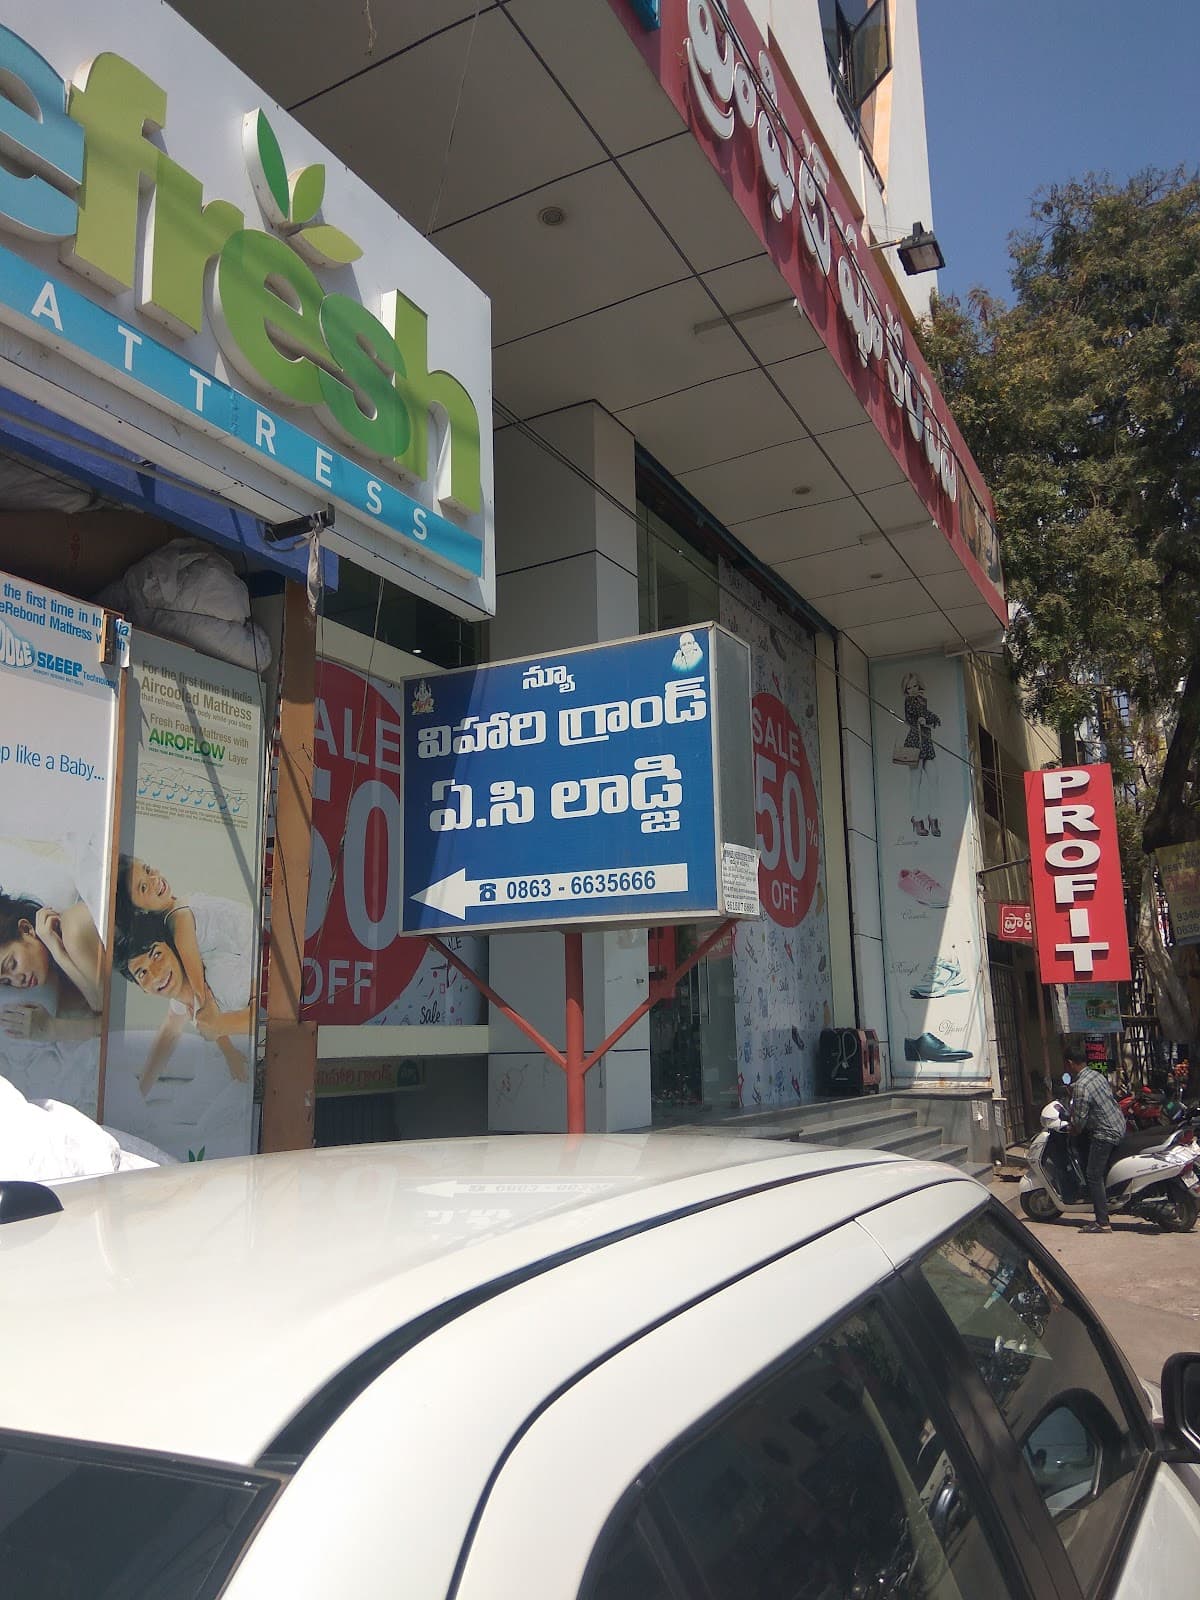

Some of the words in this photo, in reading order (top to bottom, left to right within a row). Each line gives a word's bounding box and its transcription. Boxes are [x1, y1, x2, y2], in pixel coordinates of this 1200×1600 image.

[4, 584, 21, 600] the
[26, 591, 46, 609] first
[50, 600, 74, 618] time
[79, 608, 88, 623] in
[50, 616, 92, 641] Mattress
[38, 651, 83, 677] SLEEP
[143, 660, 158, 674] For
[161, 667, 177, 680] the
[179, 672, 198, 687] first
[200, 679, 219, 693] time
[222, 685, 230, 697] in
[232, 689, 253, 705] India
[522, 665, 576, 693] న్యూ
[141, 676, 200, 705] Aircooled
[203, 694, 252, 721] Mattress
[417, 710, 547, 759] విహారి
[558, 676, 707, 747] గ్రాండ్
[148, 728, 226, 760] AIROFLOW
[228, 752, 248, 766] Layer
[150, 713, 173, 729] Fresh
[175, 719, 200, 736] Foam
[201, 727, 232, 744] Mattress
[233, 737, 249, 749] with
[314, 696, 401, 774] ALE
[752, 706, 800, 767] SALE
[16, 744, 41, 768] like
[45, 755, 55, 770] a
[60, 754, 105, 781] Baby...
[429, 779, 535, 832] ఏ.సి
[550, 753, 683, 834] లాడ్జి
[506, 879, 551, 900] 0863
[571, 870, 656, 894] 6635666
[1042, 769, 1110, 972] PROFIT
[771, 878, 799, 915] OFF
